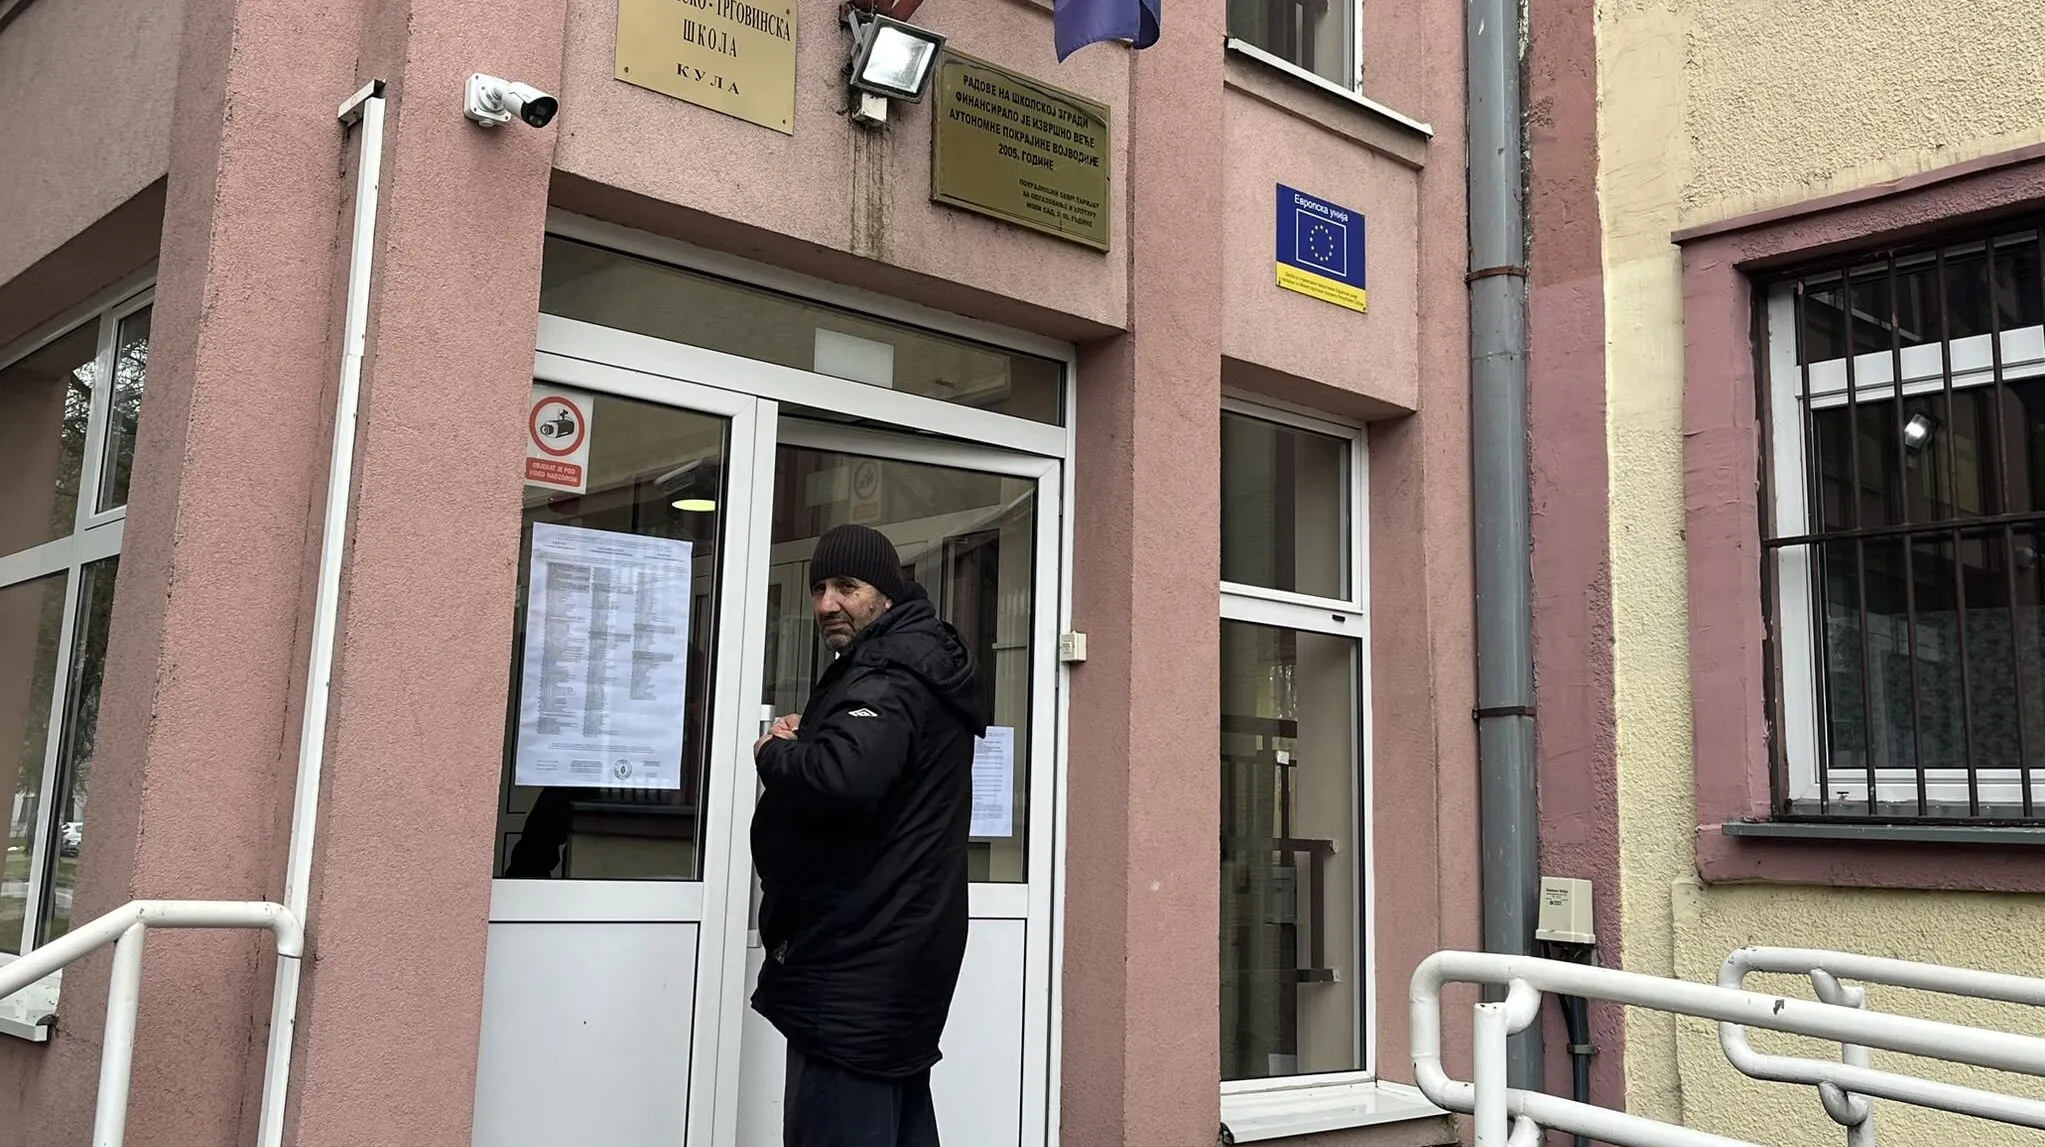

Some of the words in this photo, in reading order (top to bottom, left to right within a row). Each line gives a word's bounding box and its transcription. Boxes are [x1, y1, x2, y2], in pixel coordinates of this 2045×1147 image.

[683, 18, 737, 58] ШКОЛА
[676, 62, 740, 95] КУЛА
[955, 91, 1019, 122] ФИНАНСИРАЛО
[1020, 114, 1031, 127] ЈЕ
[1032, 118, 1072, 141] ИЗВРШНО
[1073, 133, 1095, 149] ВЕЋЕ
[962, 74, 997, 96] РАДОВЕ
[998, 87, 1010, 101] НА
[1012, 92, 1057, 118] ШКОЛСКОЈ
[1058, 108, 1089, 130] ЗГРАДИ
[949, 107, 1001, 135] АУТОНОМНЕ
[1002, 125, 1051, 152] ПОКРАЈИНЕ
[1052, 142, 1100, 168] ВОЈВОДИНЕ
[998, 143, 1020, 160] 2005.
[1021, 150, 1054, 171] ГОДИНЕ
[1294, 193, 1329, 215] Европска
[1330, 208, 1349, 223] унија
